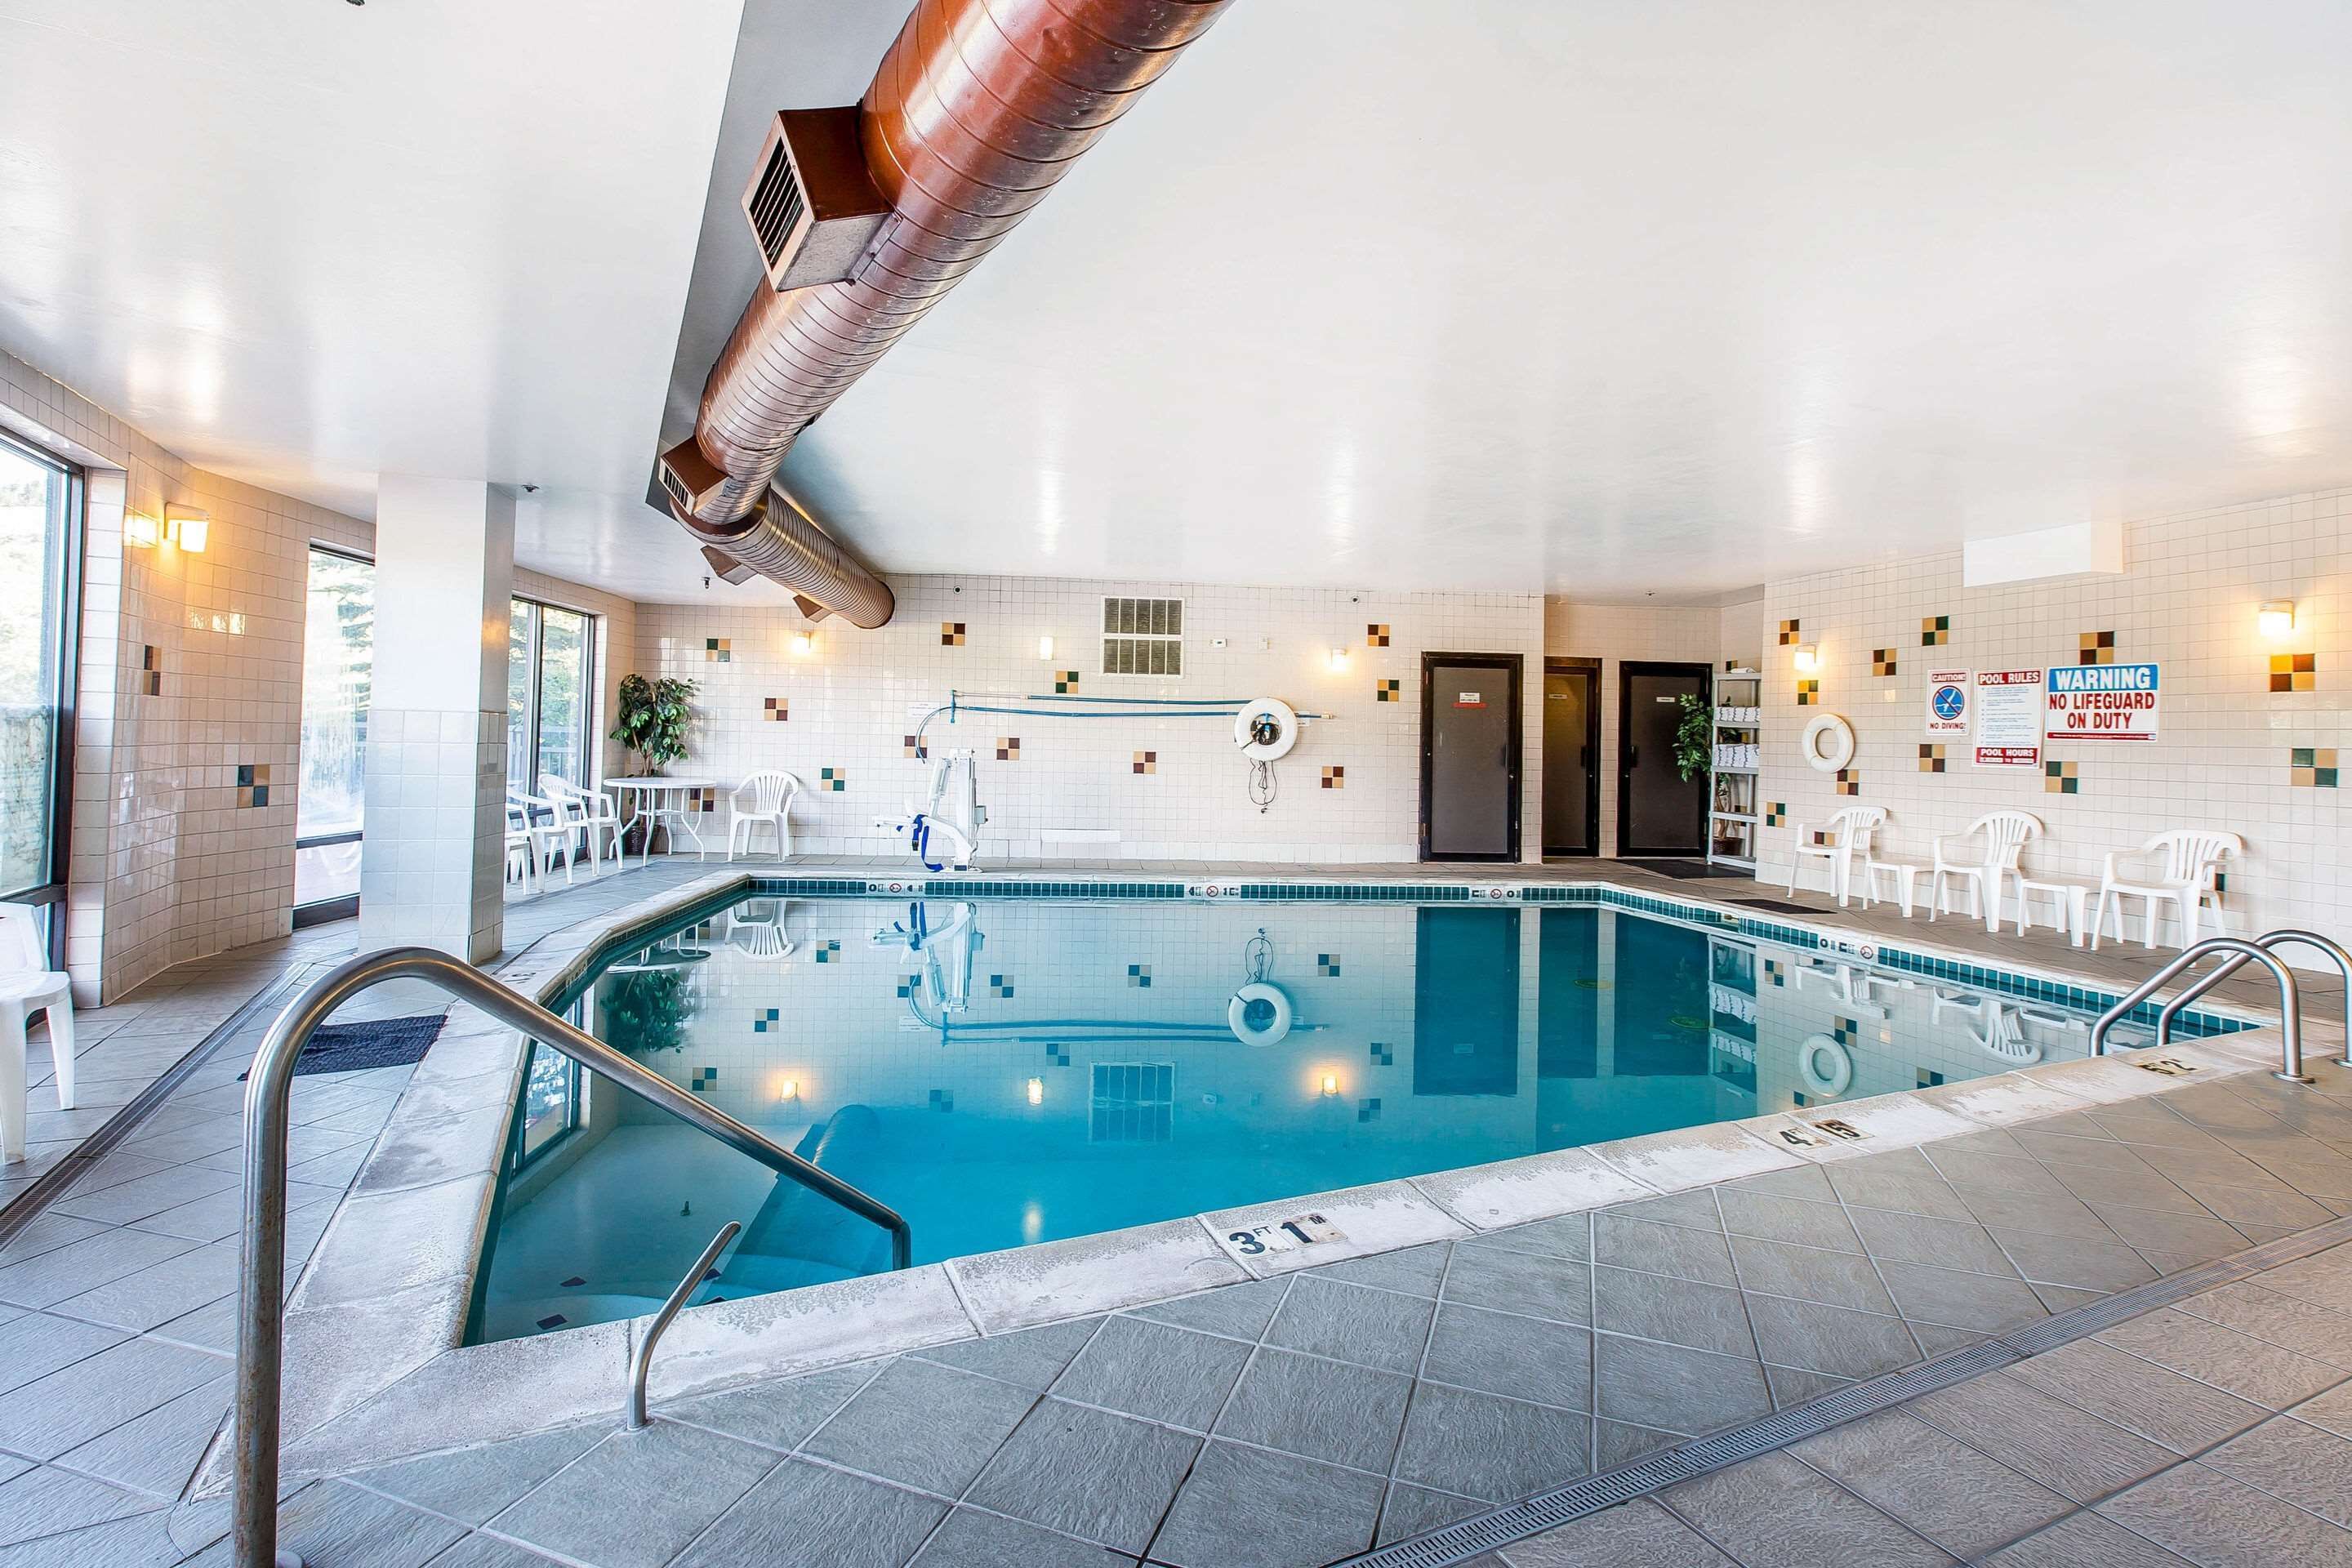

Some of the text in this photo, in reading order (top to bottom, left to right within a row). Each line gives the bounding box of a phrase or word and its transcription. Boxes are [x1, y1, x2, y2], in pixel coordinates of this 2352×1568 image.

[1979, 672, 2039, 684] POOL RULES
[2056, 667, 2150, 690] WARNING
[2049, 693, 2155, 710] NO LIFEGUARD
[2067, 712, 2132, 728] ON DUTY
[1980, 748, 2034, 757] POOL HOURS
